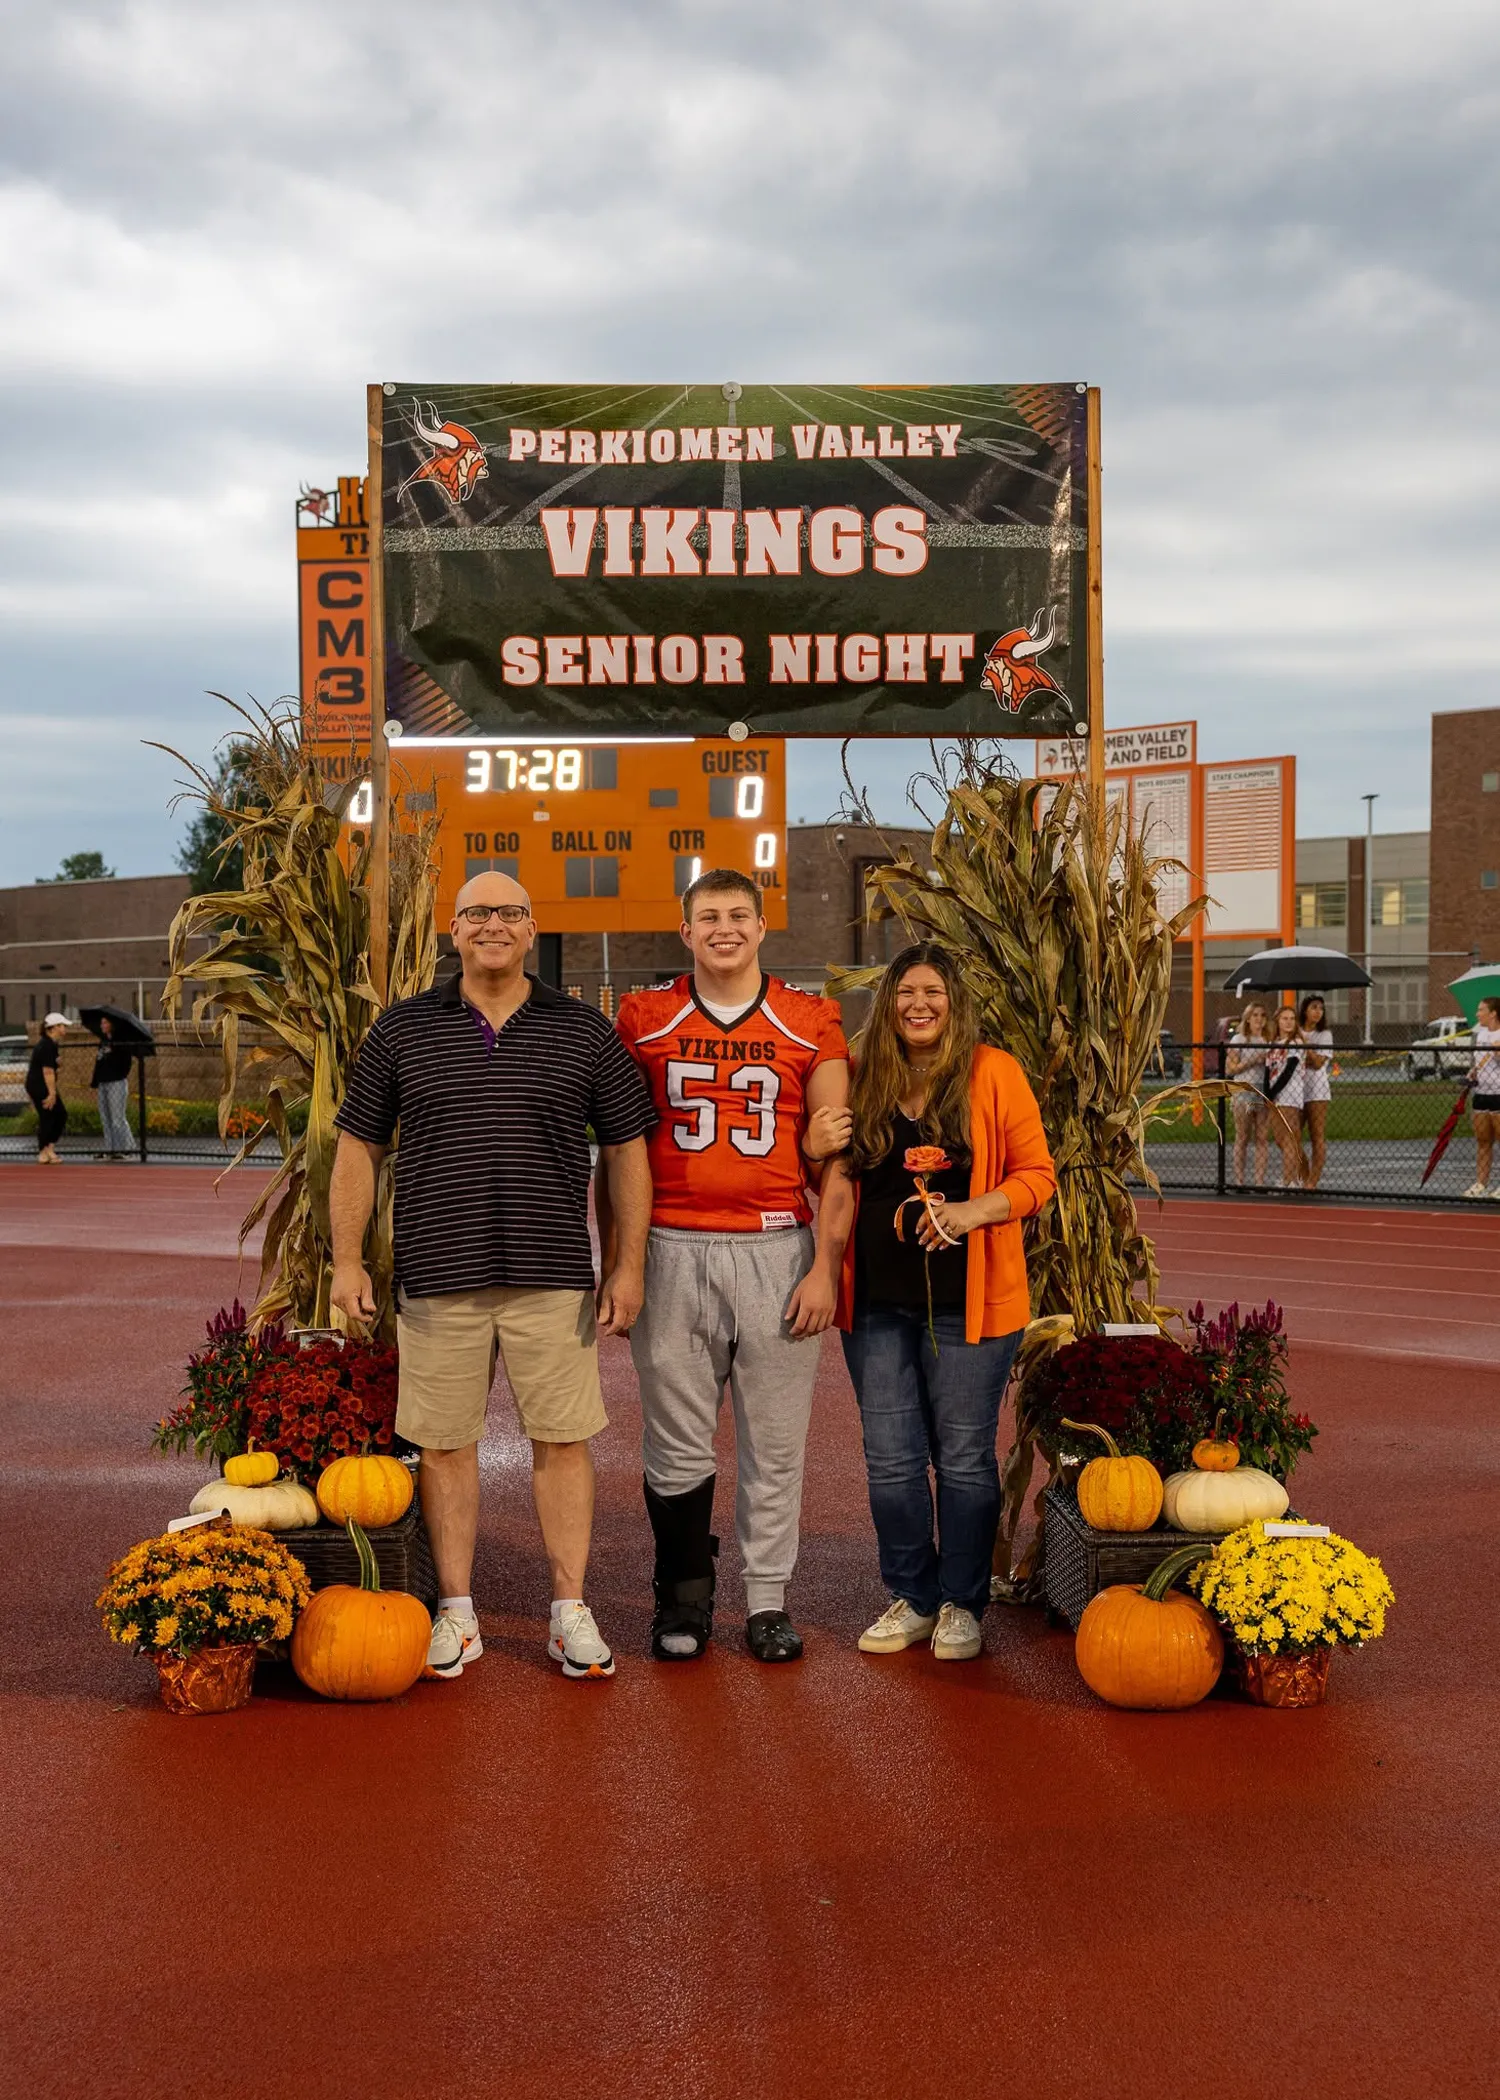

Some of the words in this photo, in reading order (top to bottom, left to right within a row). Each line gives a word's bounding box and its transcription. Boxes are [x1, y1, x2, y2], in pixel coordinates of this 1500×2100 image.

[508, 426, 774, 464] PERKIOMEN
[791, 424, 962, 460] VALLEY
[540, 505, 929, 577] VIKINGS
[501, 634, 745, 686] SENIOR
[769, 632, 975, 684] NIGHT
[1138, 729, 1188, 745] VALLEY
[702, 750, 769, 774] GUEST
[1111, 749, 1141, 764] AND
[1146, 745, 1188, 761] FIELD
[465, 749, 582, 793] 37:28
[737, 775, 765, 819] 0
[464, 833, 489, 853] TO
[494, 832, 520, 853] GO
[551, 832, 598, 852] BALL
[604, 830, 632, 851] ON
[669, 829, 705, 851] QTR
[754, 833, 777, 868] 0
[752, 871, 781, 888] TOL
[678, 1038, 776, 1061] VIKINGS
[665, 1059, 780, 1158] 53
